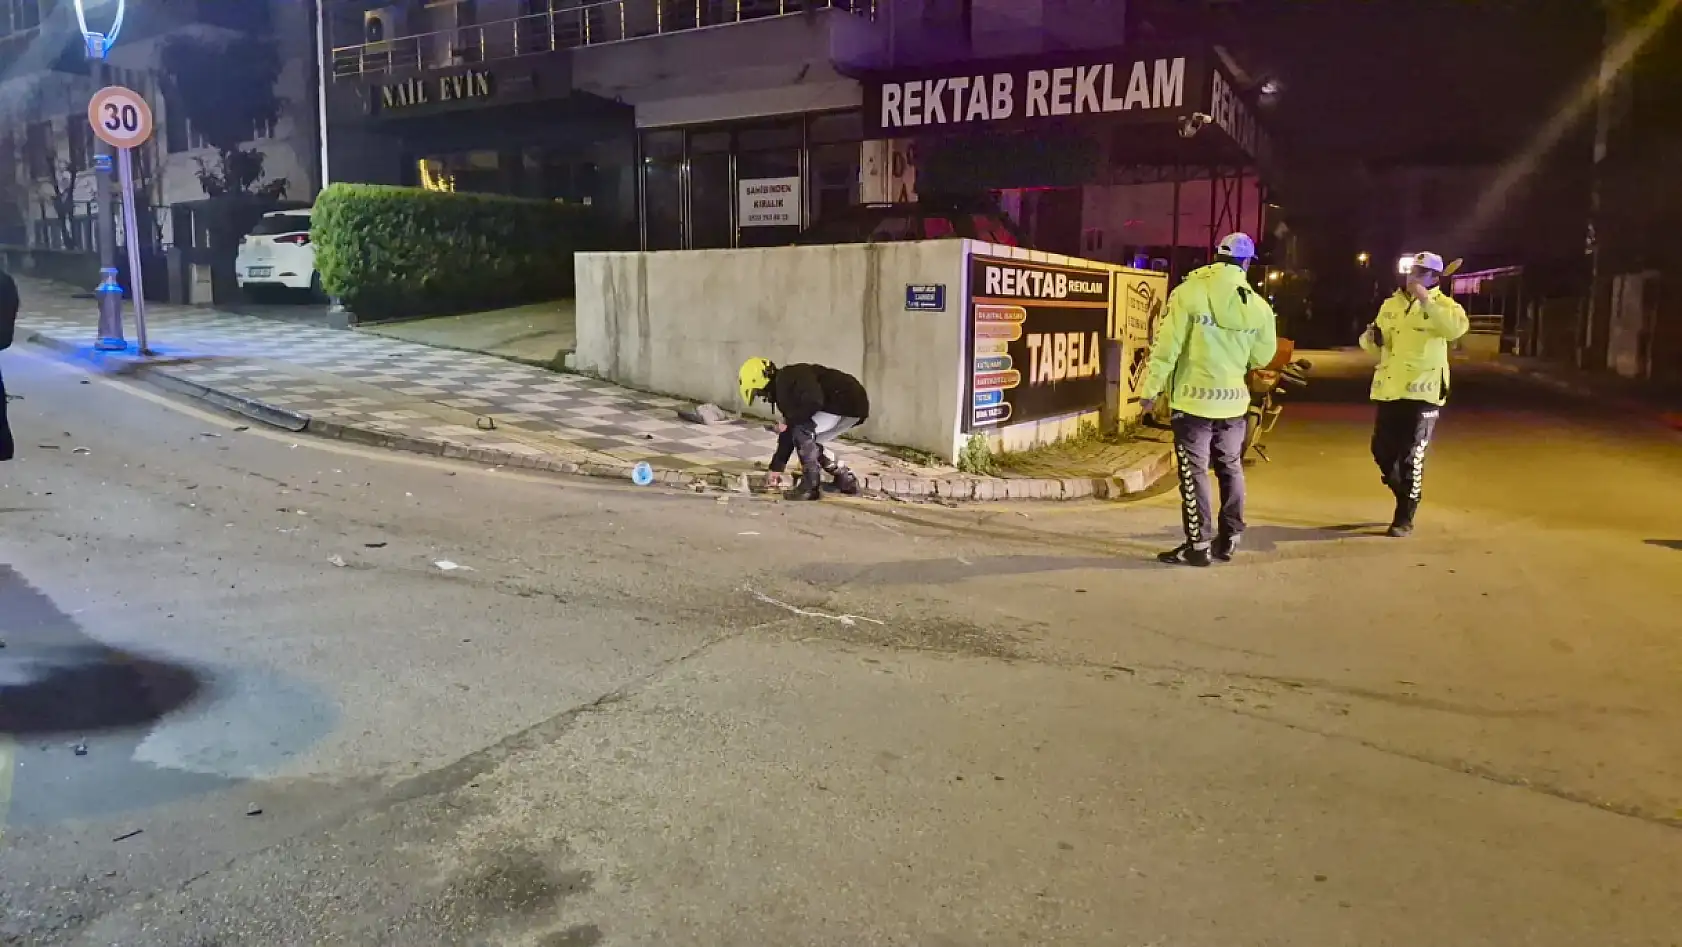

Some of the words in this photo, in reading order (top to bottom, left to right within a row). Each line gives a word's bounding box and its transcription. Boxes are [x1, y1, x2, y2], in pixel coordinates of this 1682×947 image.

[881, 72, 1013, 128] REKTAB
[1026, 57, 1186, 117] REKLAM
[104, 103, 138, 131] 30
[985, 266, 1067, 298] REKTAB
[1068, 279, 1103, 294] REKLAM
[1026, 331, 1100, 385] TABELA
